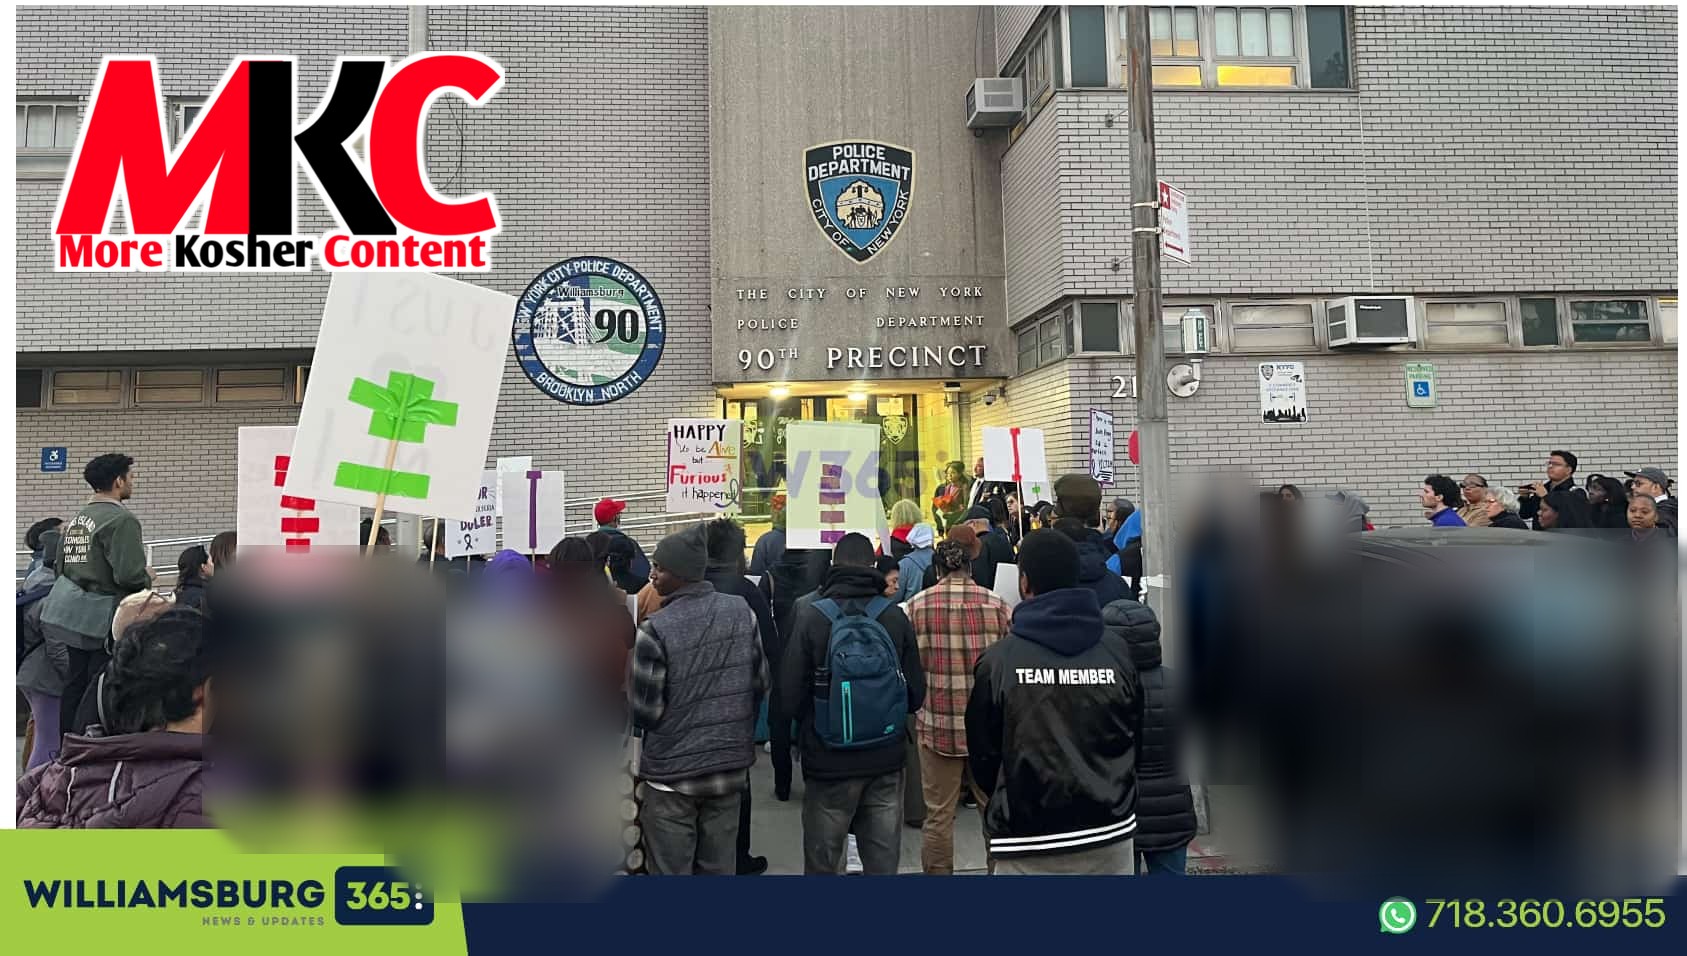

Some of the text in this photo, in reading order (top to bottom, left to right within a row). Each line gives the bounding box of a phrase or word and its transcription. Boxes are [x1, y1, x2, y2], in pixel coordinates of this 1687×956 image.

[832, 144, 886, 160] POLICE
[808, 159, 911, 181] DEPARTMENT
[812, 198, 850, 247] CITY OF
[867, 189, 909, 255] NEW YORK
[525, 278, 549, 303] YORK
[546, 263, 572, 283] CITY
[574, 260, 610, 274] POLICE
[612, 264, 663, 332] DEPARTMENT
[557, 285, 624, 297] Williamsburg
[736, 287, 983, 300] THE CITY OF NEW YORK
[594, 308, 640, 344] 90
[737, 315, 985, 330] POLICE DEPARTMENT
[826, 345, 987, 369] PRECINCT
[536, 370, 642, 402] BROOKLYN NORTH
[673, 425, 726, 442] HAPPY
[670, 465, 727, 485] Furious
[460, 515, 493, 531] DULER
[1016, 668, 1116, 685] TEAM MEMBER
